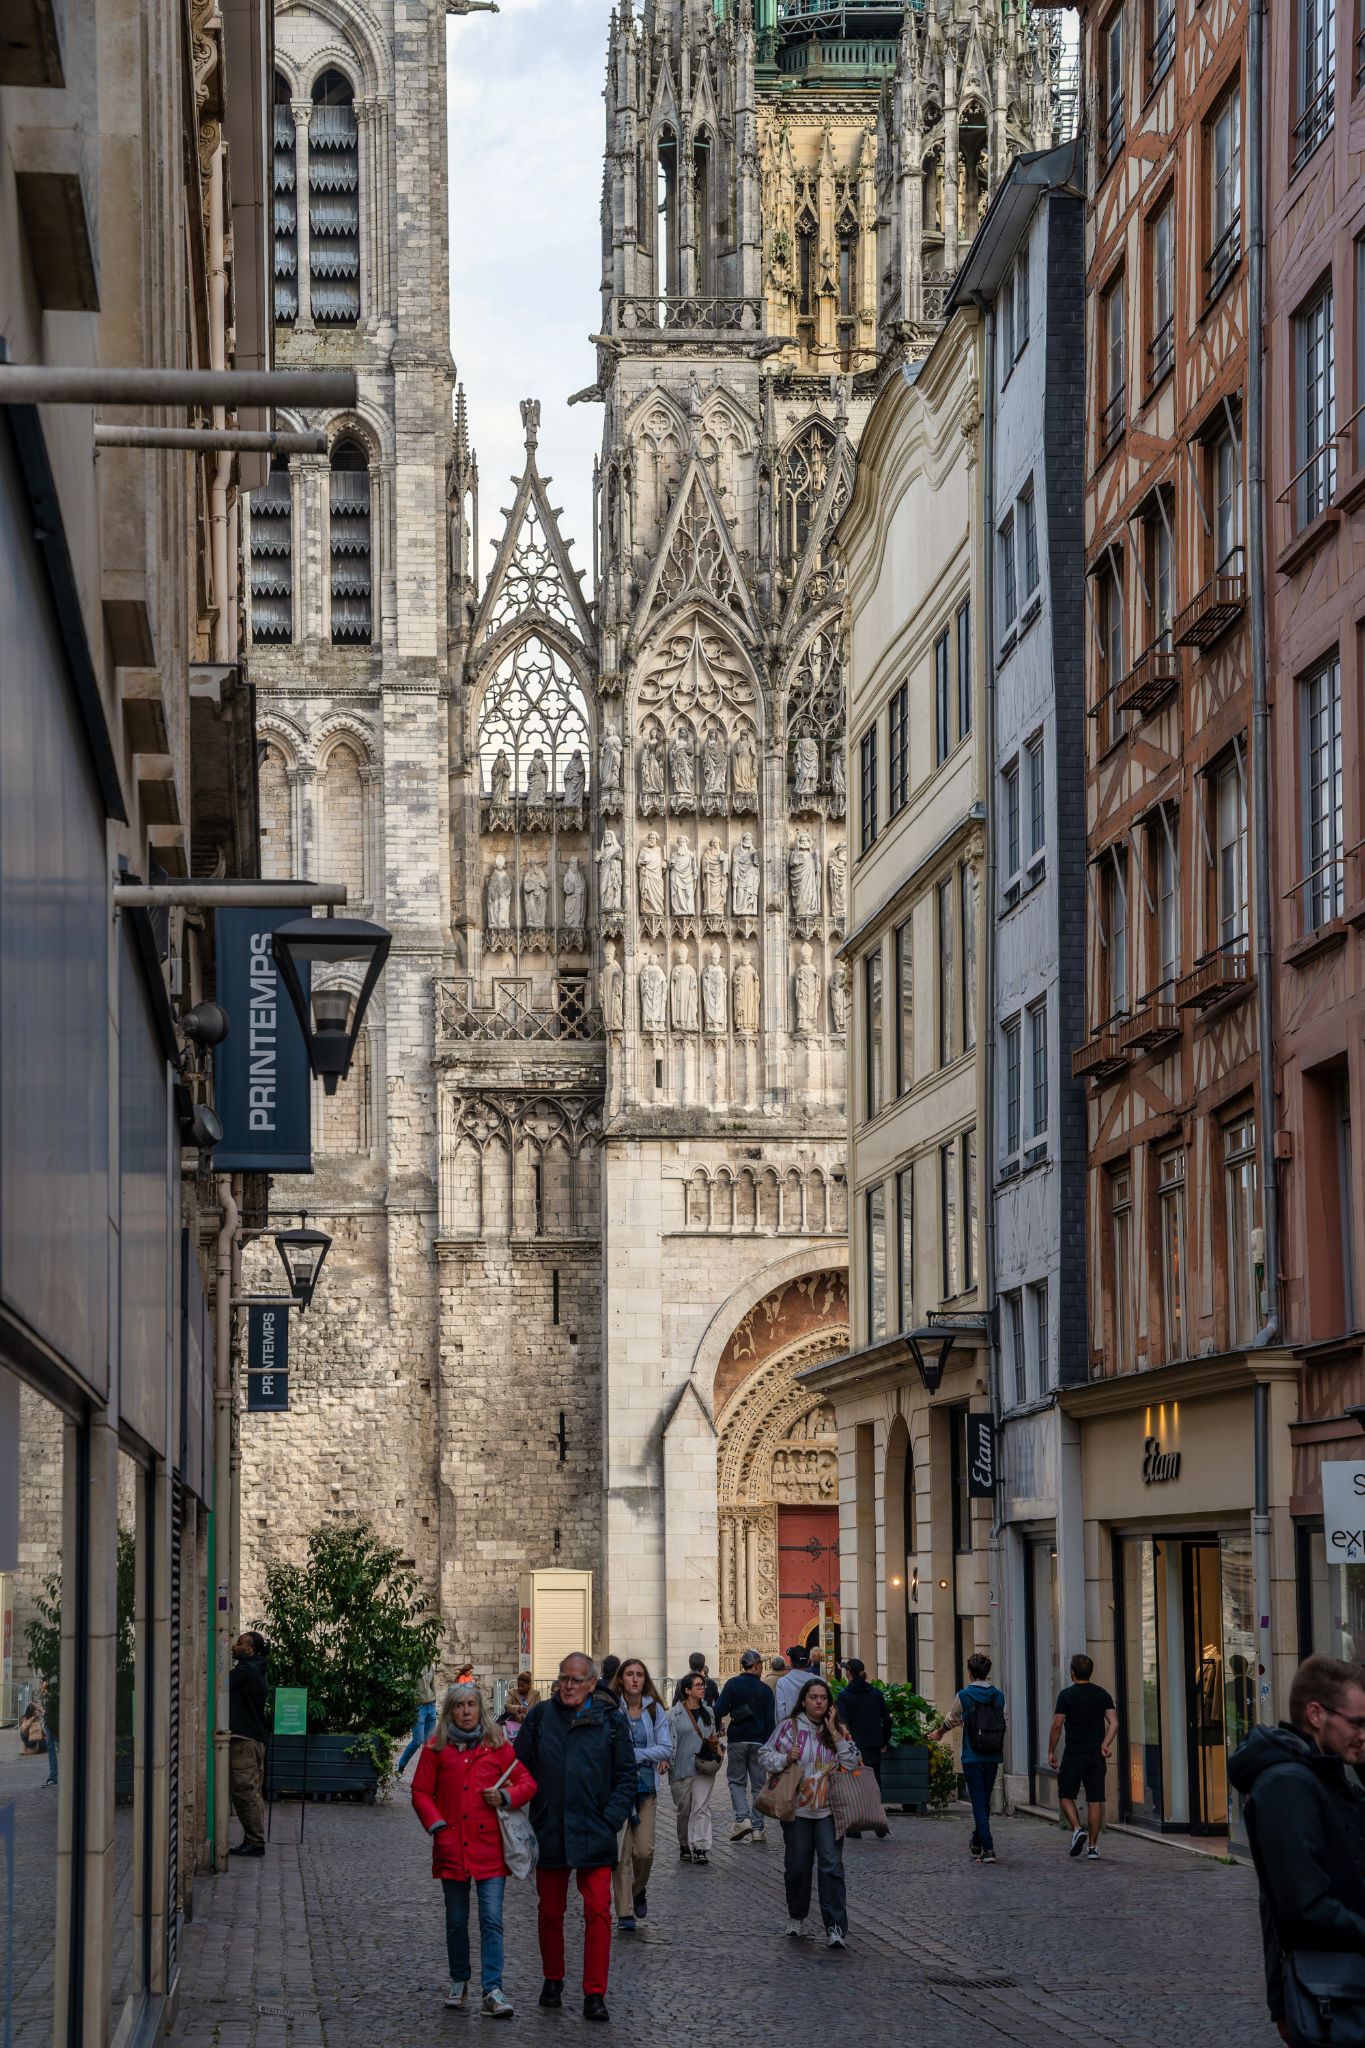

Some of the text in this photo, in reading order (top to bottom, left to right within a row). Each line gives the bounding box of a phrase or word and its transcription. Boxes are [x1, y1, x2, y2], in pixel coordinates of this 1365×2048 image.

[249, 933, 277, 1131] PRINTEMPS
[972, 1423, 993, 1487] Etam
[1141, 1436, 1182, 1483] Etam
[1331, 1530, 1365, 1555] ex
